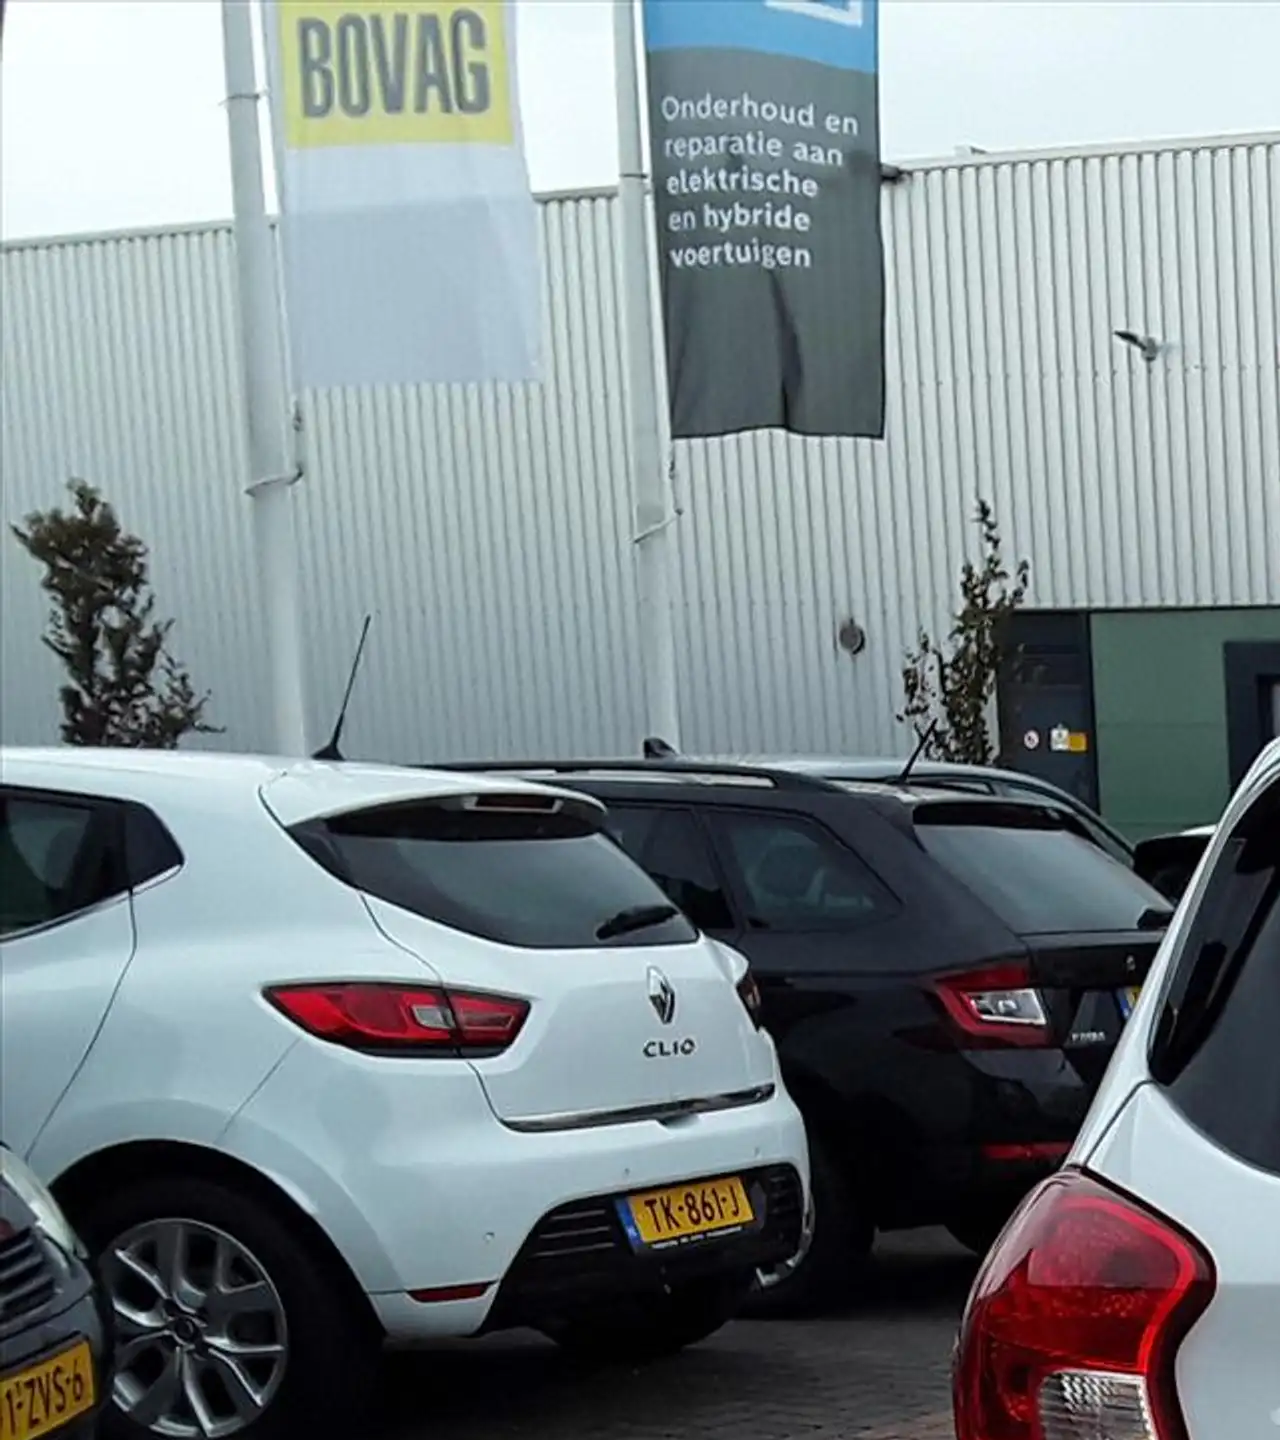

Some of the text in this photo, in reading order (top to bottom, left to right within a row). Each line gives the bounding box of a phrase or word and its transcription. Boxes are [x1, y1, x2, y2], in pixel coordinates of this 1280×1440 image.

[299, 8, 490, 119] BOVAG
[661, 92, 858, 136] Onderhoud en
[665, 130, 843, 166] reparatie aan
[666, 165, 819, 198] elektrische
[668, 202, 811, 233] en hybride
[669, 237, 811, 269] voertuigen
[642, 1038, 696, 1058] CLIO
[644, 1184, 740, 1233] TK-861-J
